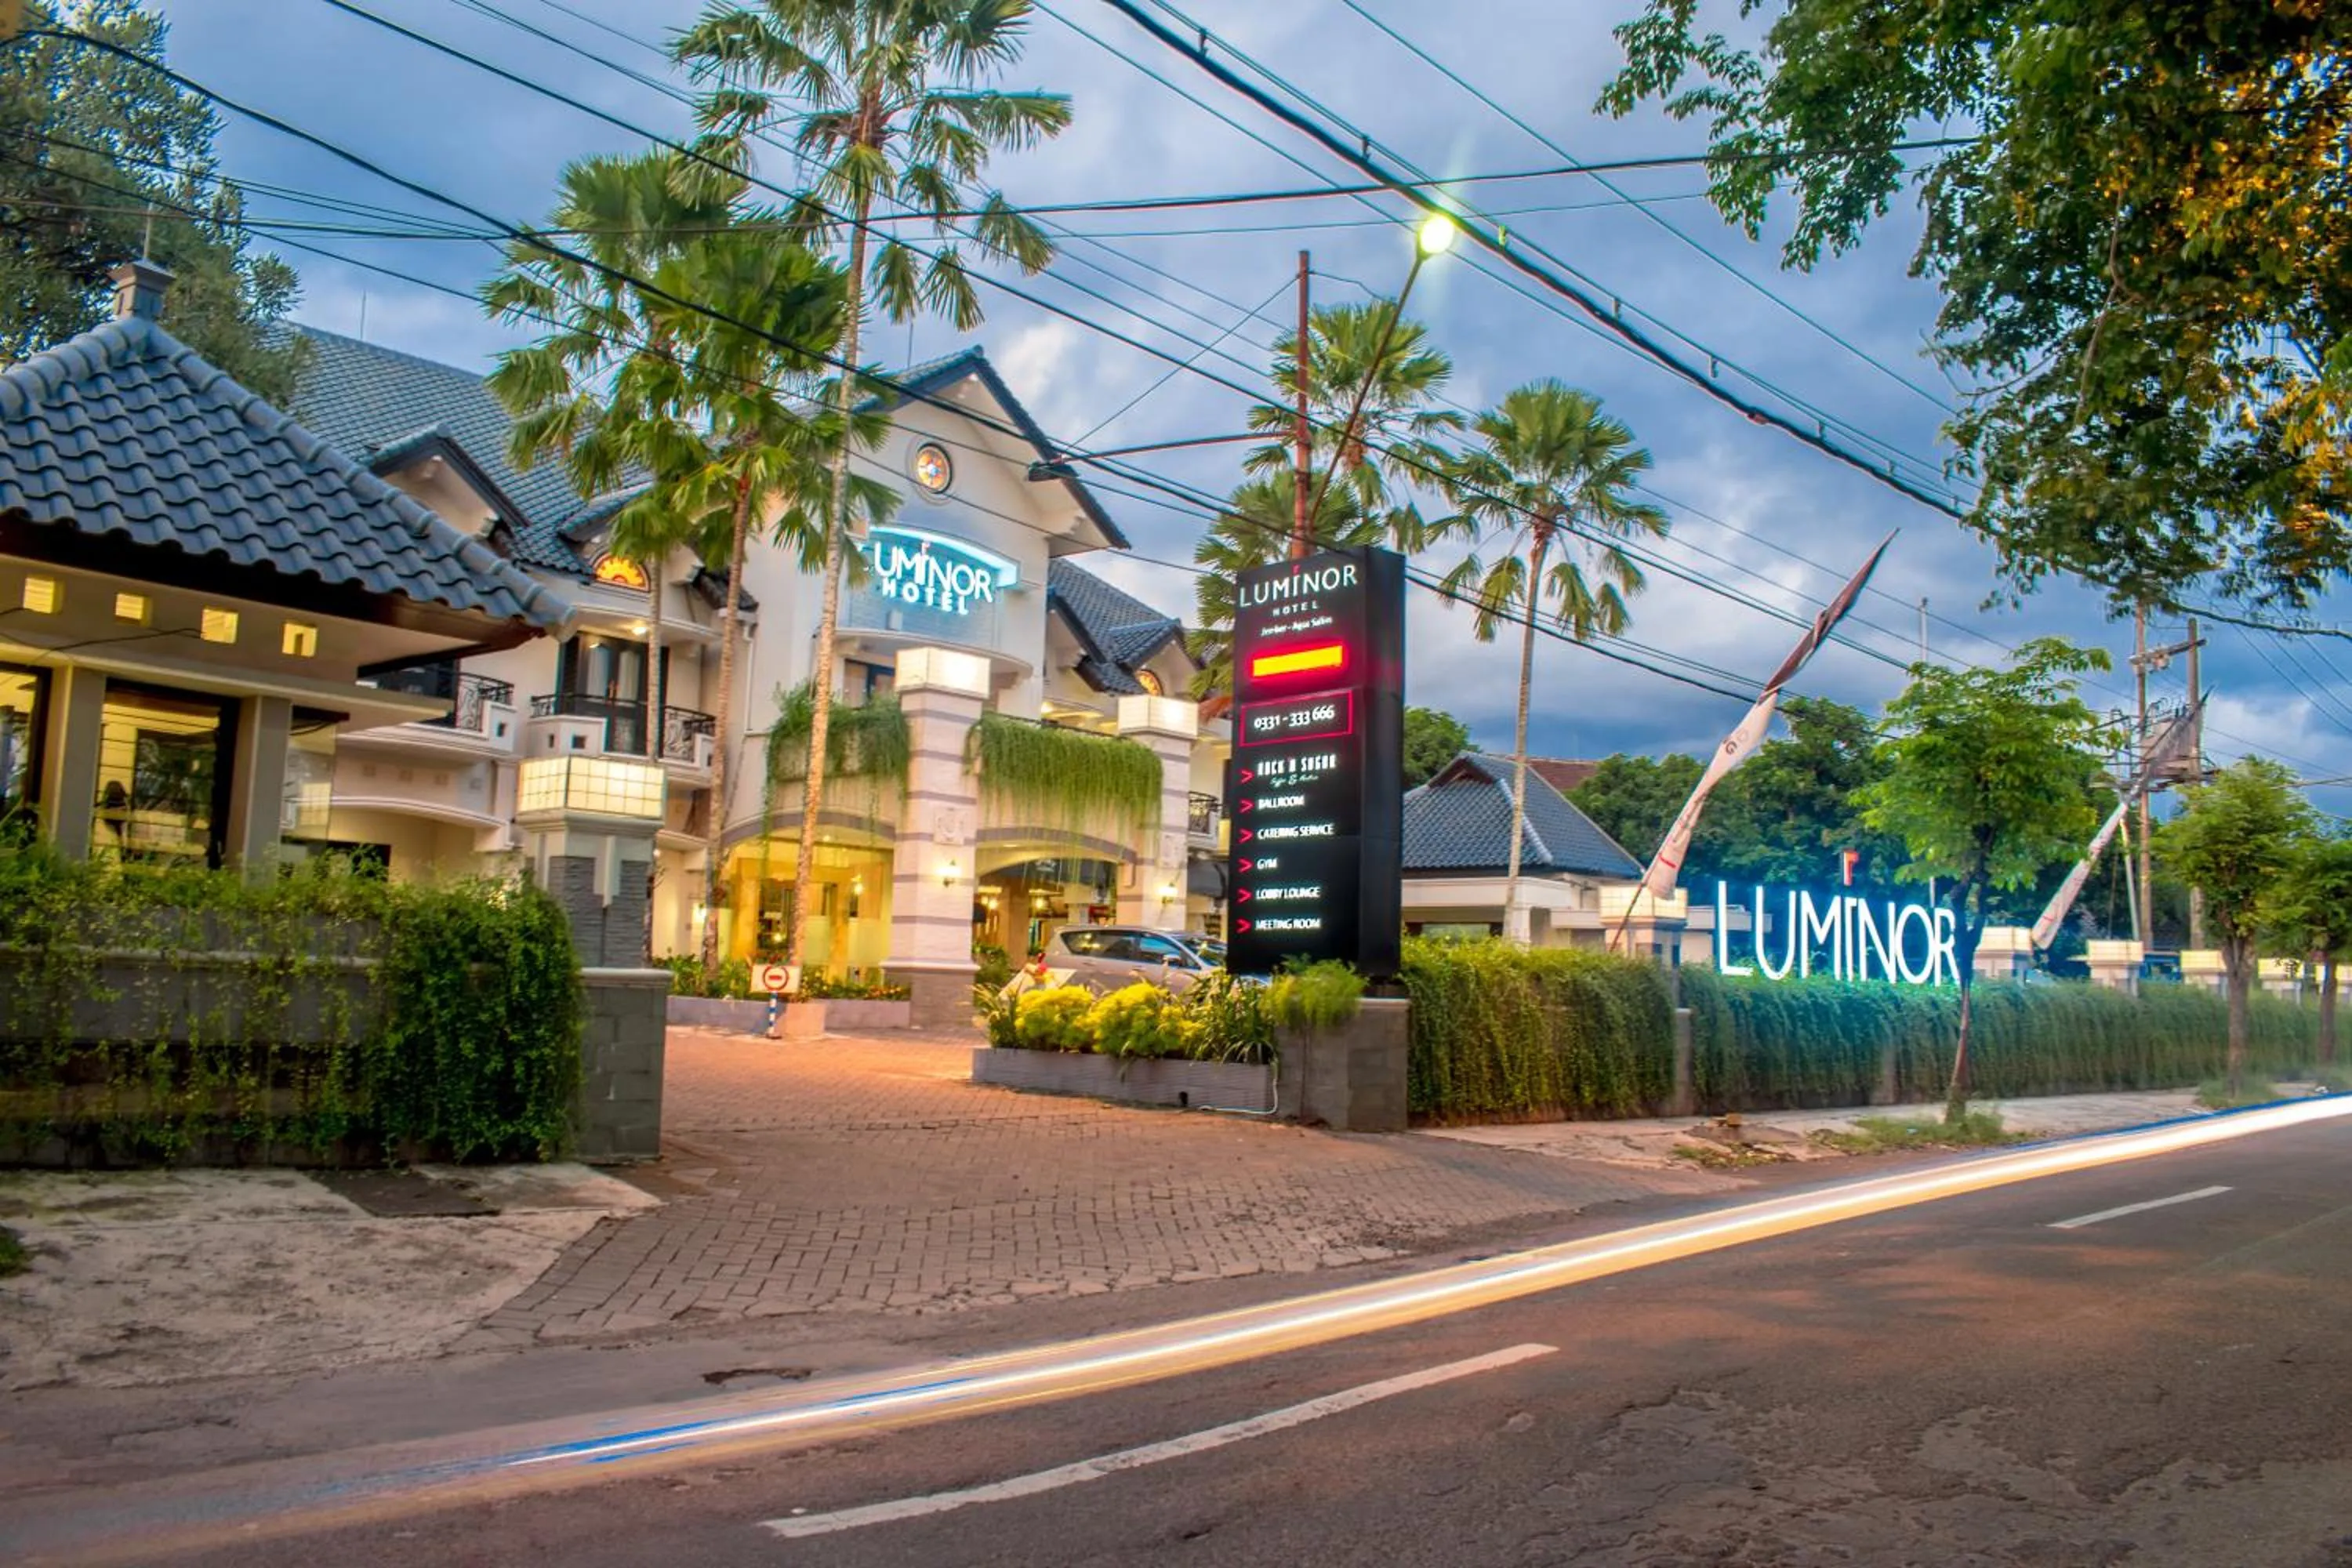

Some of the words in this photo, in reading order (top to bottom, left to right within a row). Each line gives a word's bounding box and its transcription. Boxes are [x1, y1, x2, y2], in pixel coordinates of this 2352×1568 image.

[858, 539, 993, 603] UMINOR
[1239, 564, 1358, 608] LUMINOR
[882, 577, 969, 615] HOTEL
[1272, 600, 1319, 617] HOTEL
[1312, 705, 1335, 721] 666
[1257, 858, 1278, 869] GYM
[1718, 851, 1960, 988] LUMINOR
